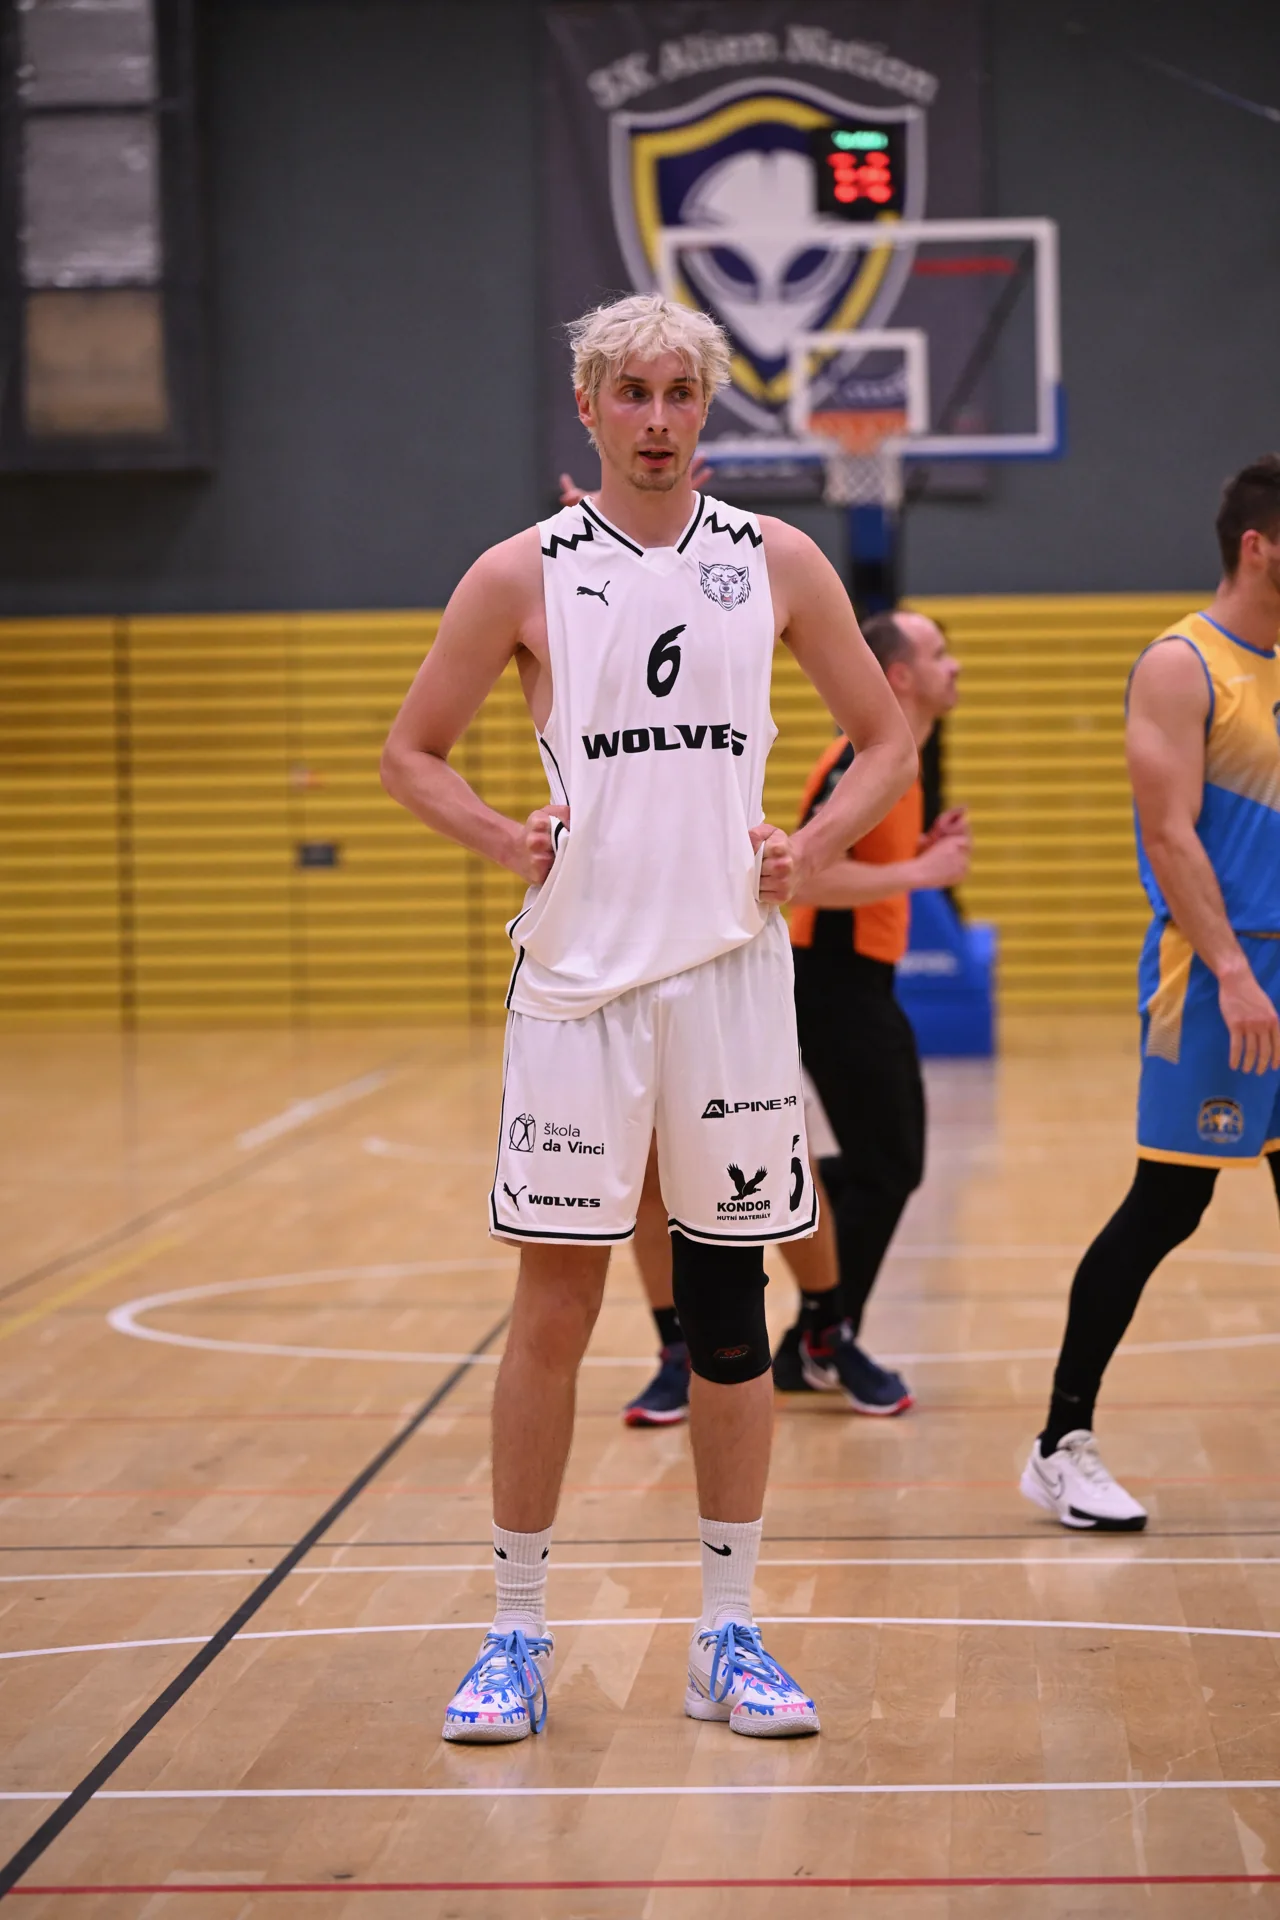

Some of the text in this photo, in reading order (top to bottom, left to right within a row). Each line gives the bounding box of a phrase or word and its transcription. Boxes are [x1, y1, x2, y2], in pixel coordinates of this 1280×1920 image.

[659, 31, 779, 82] Alien
[647, 624, 686, 697] 6
[582, 723, 747, 759] WOLVES
[701, 1099, 781, 1119] ALPINE
[544, 1123, 580, 1137] škola
[543, 1139, 604, 1155] da Vinci
[528, 1195, 600, 1207] WOLVES
[717, 1199, 770, 1212] KONDOR
